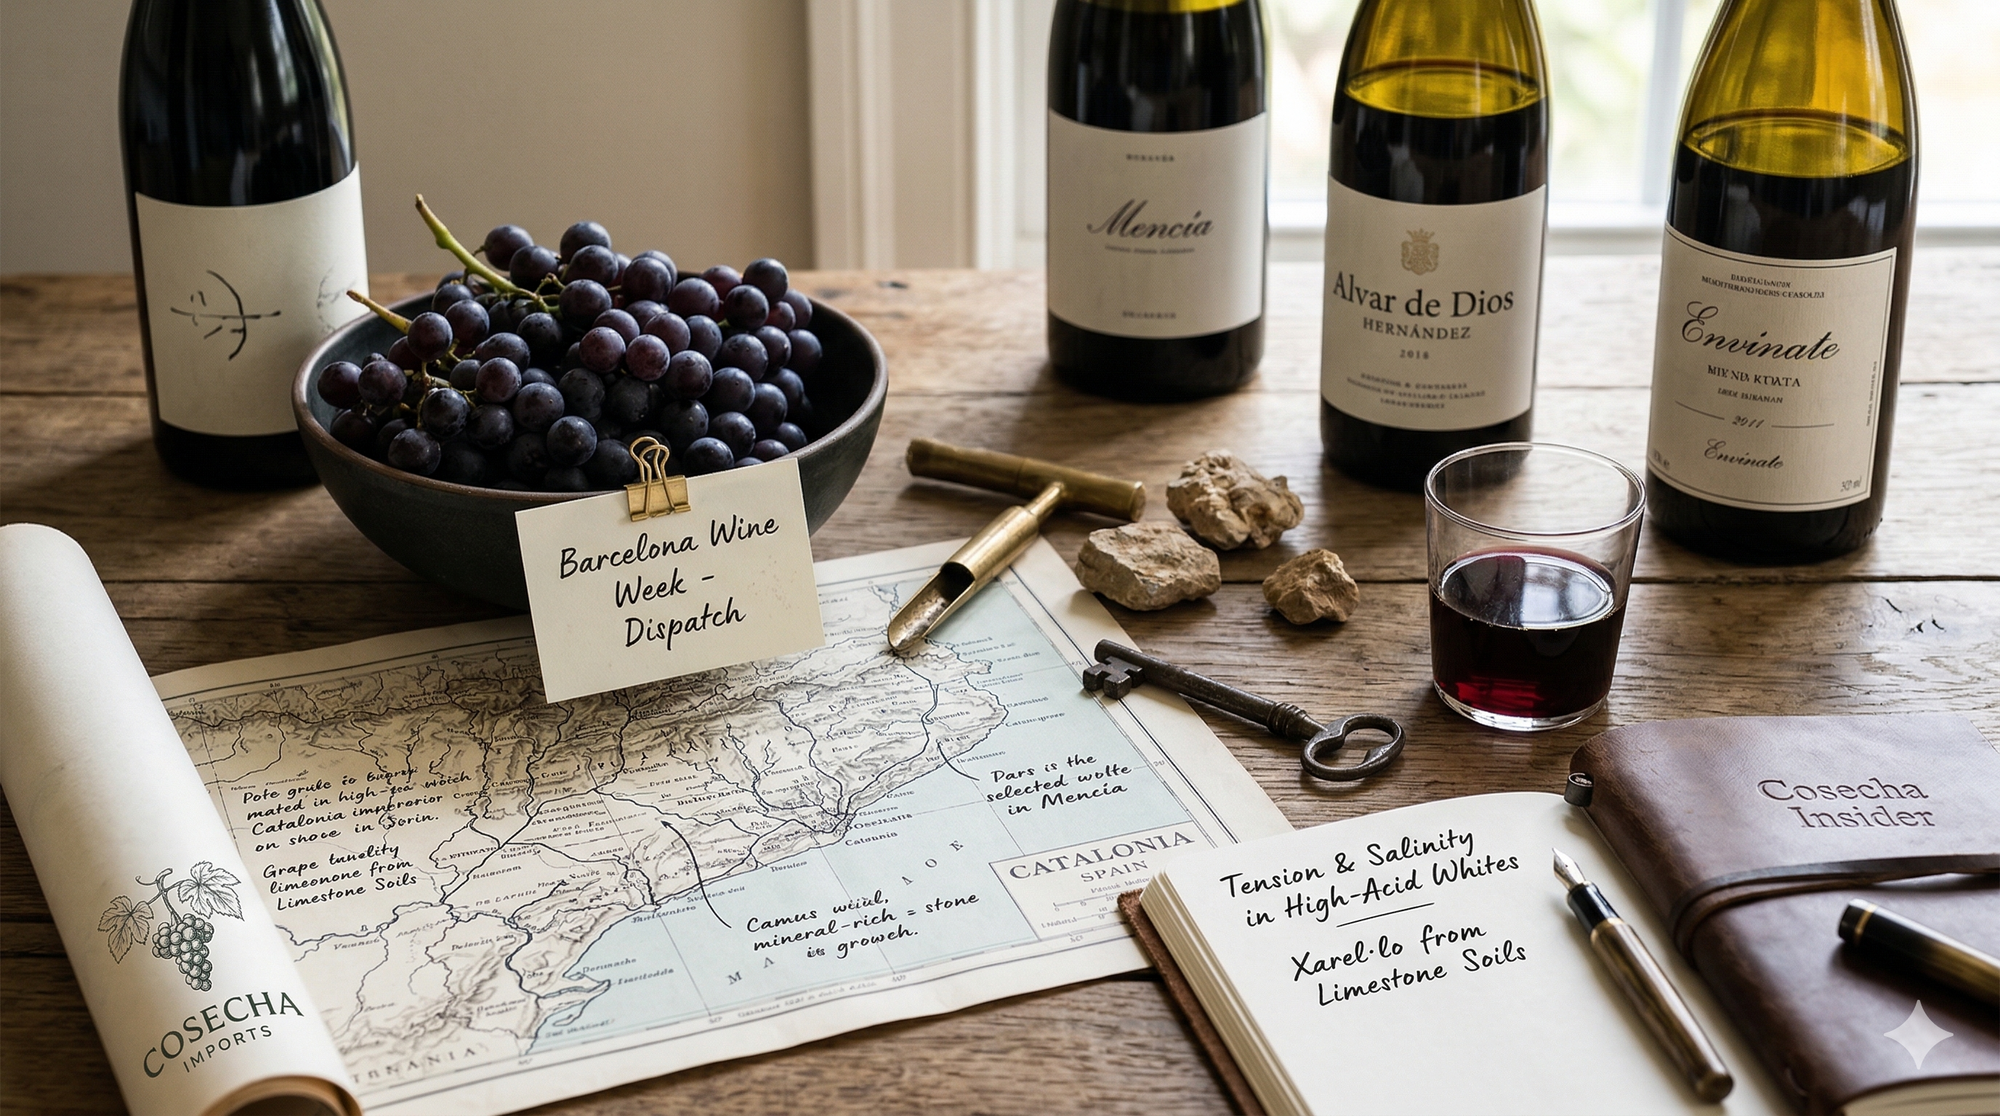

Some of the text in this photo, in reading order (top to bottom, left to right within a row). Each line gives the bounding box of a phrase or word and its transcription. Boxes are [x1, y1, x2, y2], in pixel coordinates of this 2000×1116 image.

[1332, 270, 1514, 318] Alvar de Dios
[1363, 316, 1472, 340] HERNÁNDEZ
[1681, 301, 1841, 361] Envinate
[1703, 438, 1784, 470] Envinate
[559, 514, 780, 580] Barcelona Wine
[615, 567, 688, 609] Week
[625, 596, 747, 651] Dispatch
[1044, 759, 1059, 774] is
[1066, 754, 1098, 770] the
[986, 774, 1069, 803] selected
[1757, 776, 1930, 801] Cosecha
[246, 799, 306, 821] mated
[313, 798, 331, 808] in
[252, 812, 347, 836] Catalonia
[1007, 804, 1032, 816] in
[1787, 805, 1937, 829] Insider
[255, 842, 280, 853] on
[354, 823, 374, 834] in
[263, 860, 319, 879] Grape
[369, 860, 414, 878] from
[1009, 830, 1196, 881] CATALONIA
[1219, 828, 1474, 898] Tension & Salinity
[1080, 860, 1149, 884] SPAIN
[276, 872, 418, 912] Limestone Soils
[1246, 855, 1520, 928] in High-Acid Whites
[753, 907, 897, 951] mineral-rich
[925, 893, 980, 914] stone
[1419, 923, 1487, 955] from
[1317, 939, 1527, 1007] Limestone Soils
[143, 991, 305, 1078] COSECHA
[182, 1025, 273, 1074] IMPORTS
